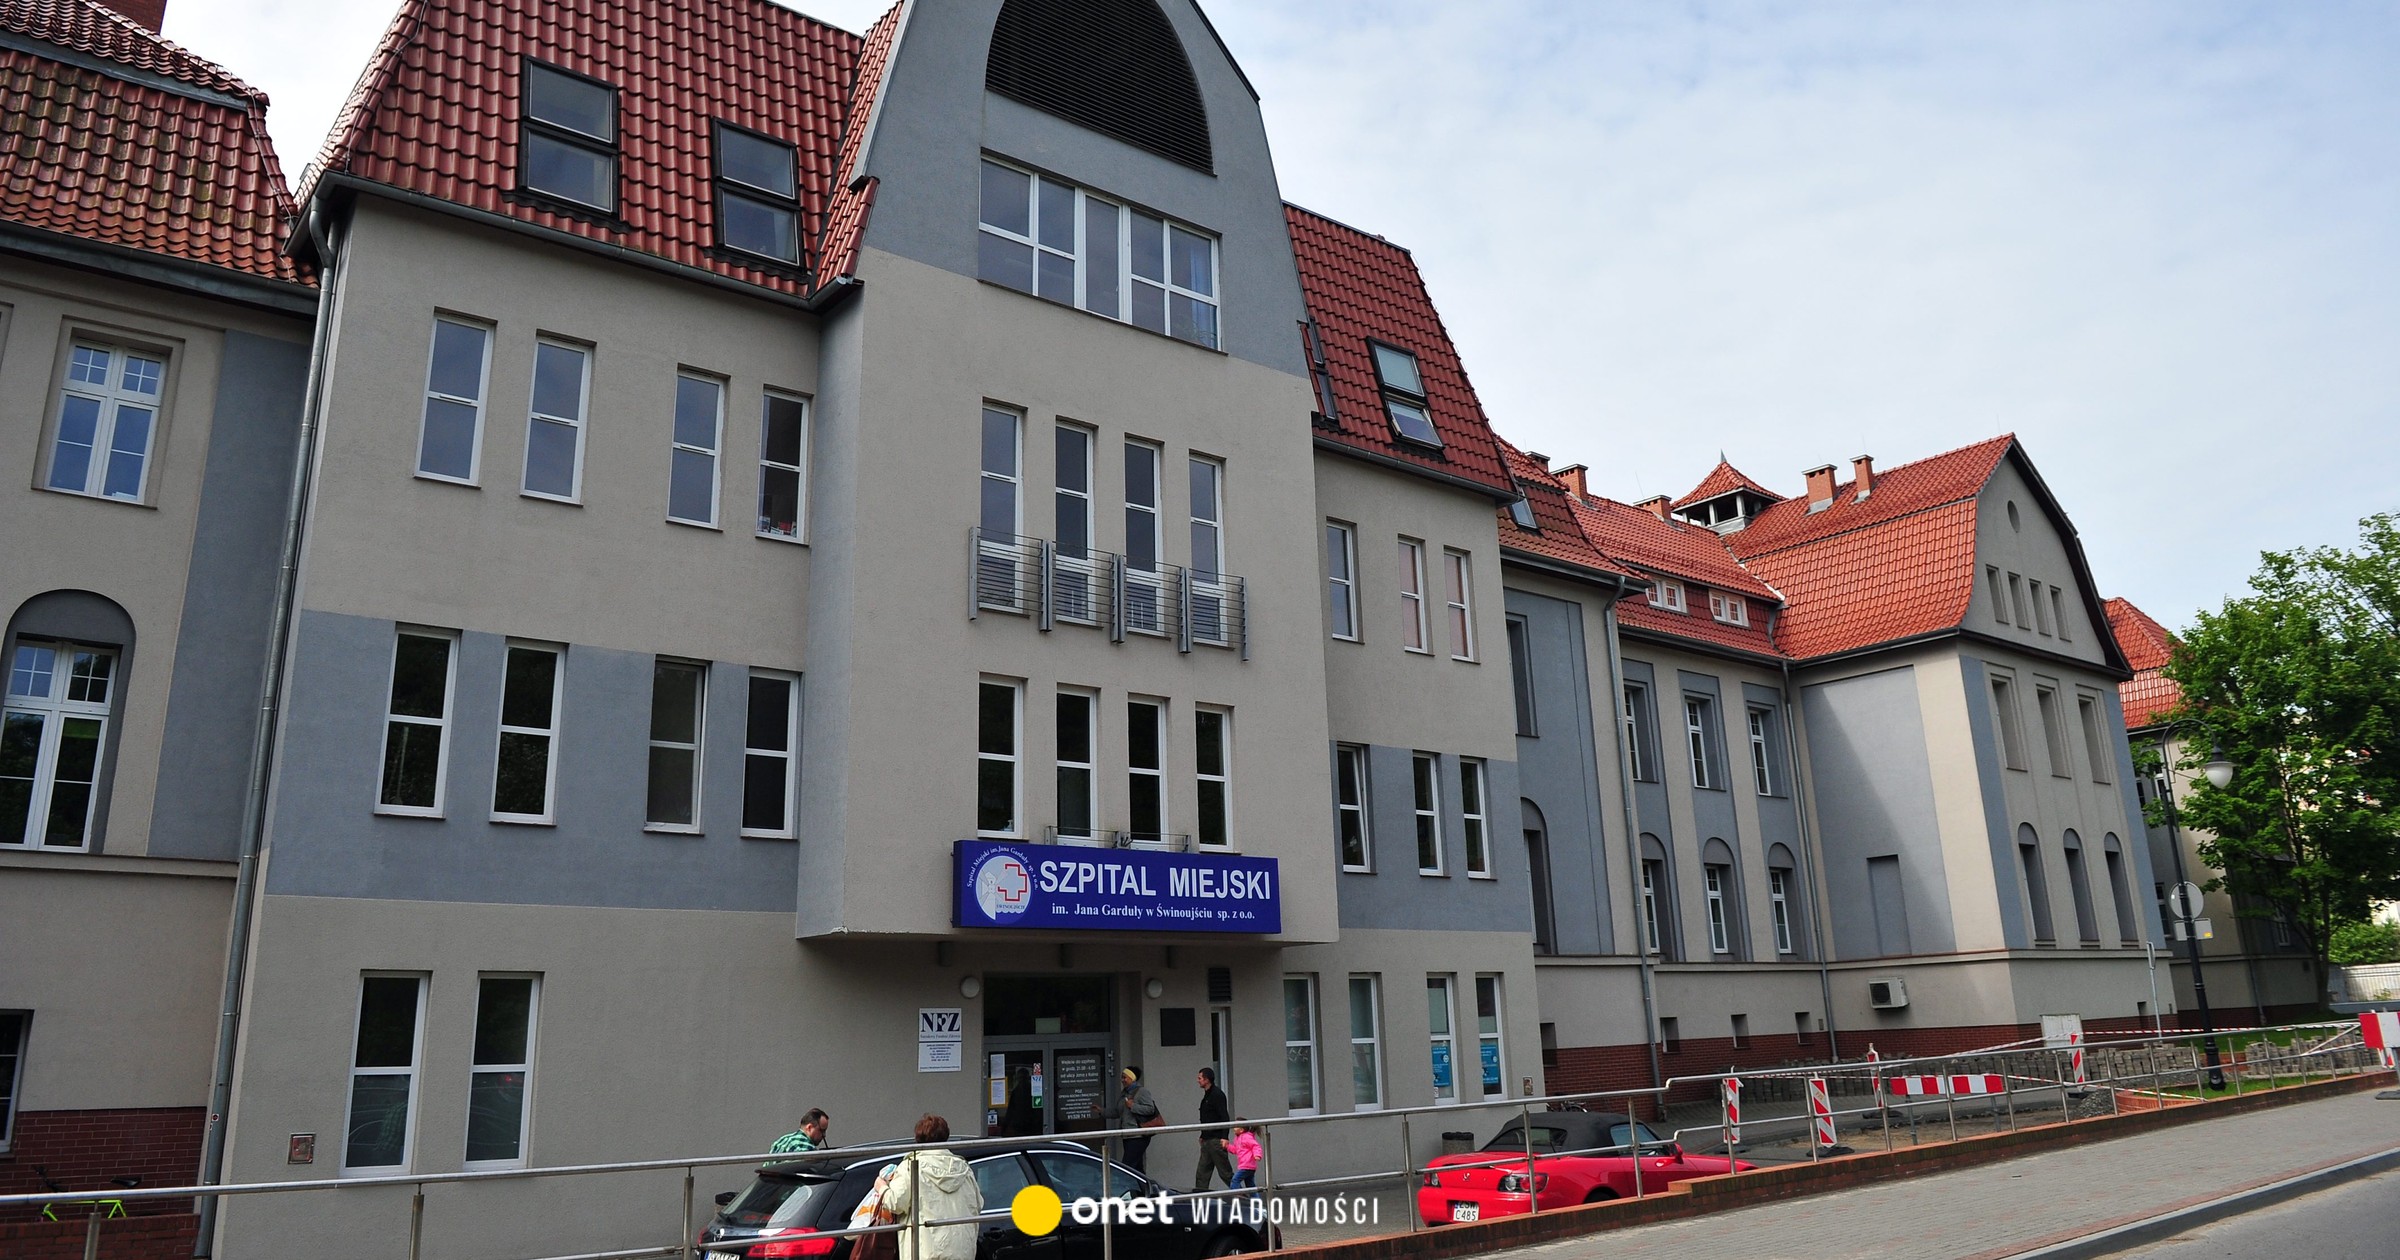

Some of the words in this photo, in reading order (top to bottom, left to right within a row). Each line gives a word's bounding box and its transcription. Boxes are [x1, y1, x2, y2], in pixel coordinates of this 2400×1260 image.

[1040, 860, 1157, 896] SZPITAL
[1169, 867, 1271, 900] MIEJSKI
[1052, 902, 1069, 915] im.
[1074, 903, 1099, 915] Jana
[1101, 904, 1143, 920] Garduły
[1145, 907, 1155, 917] w
[1156, 903, 1213, 921] Świnoujściu
[1217, 910, 1230, 921] sp.
[1232, 910, 1238, 919] z
[1239, 910, 1256, 920] o.o.
[921, 1012, 960, 1033] NFZ
[1456, 1210, 1477, 1221] C485
